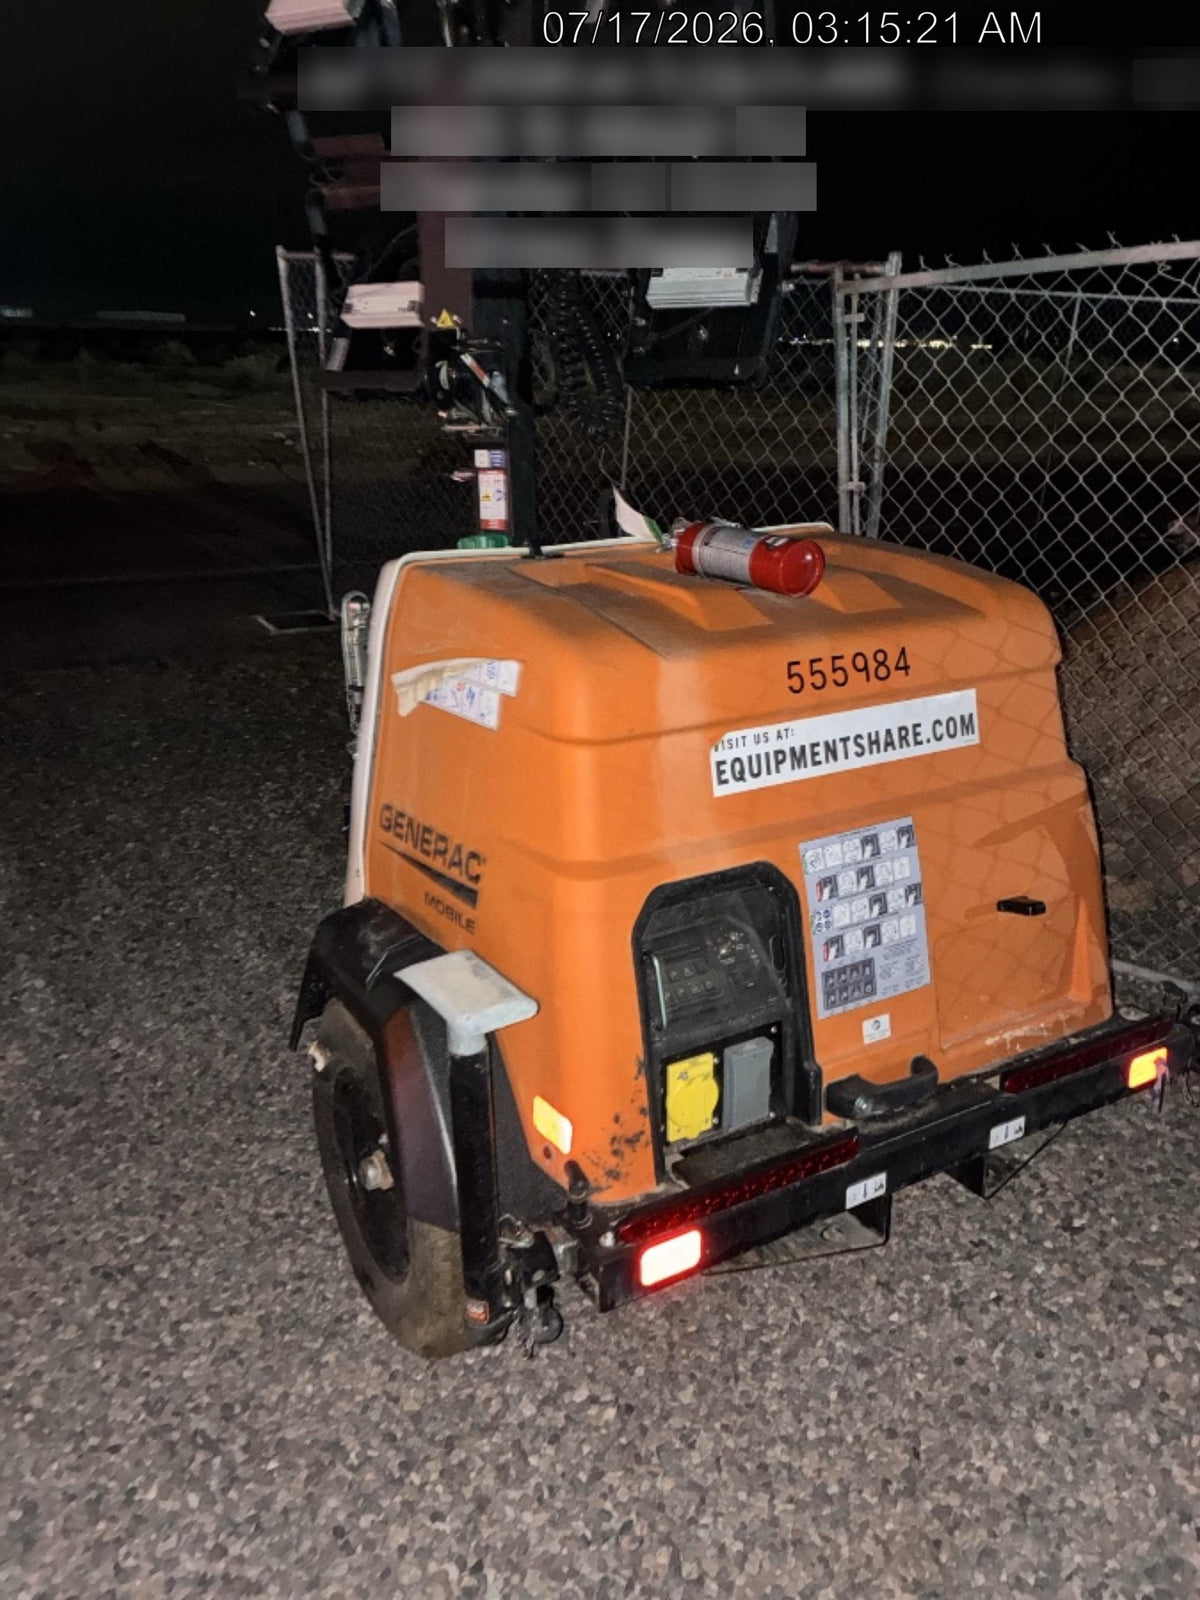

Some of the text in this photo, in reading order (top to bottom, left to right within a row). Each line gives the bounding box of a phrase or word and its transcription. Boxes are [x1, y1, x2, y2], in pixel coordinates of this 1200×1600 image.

[786, 647, 911, 694] 555984
[715, 713, 975, 785] EQUIPMENTSHARE.COM
[753, 731, 769, 745] US
[776, 727, 795, 741] AT:
[380, 804, 481, 884] GENERAC
[425, 892, 475, 933] MOBILE
